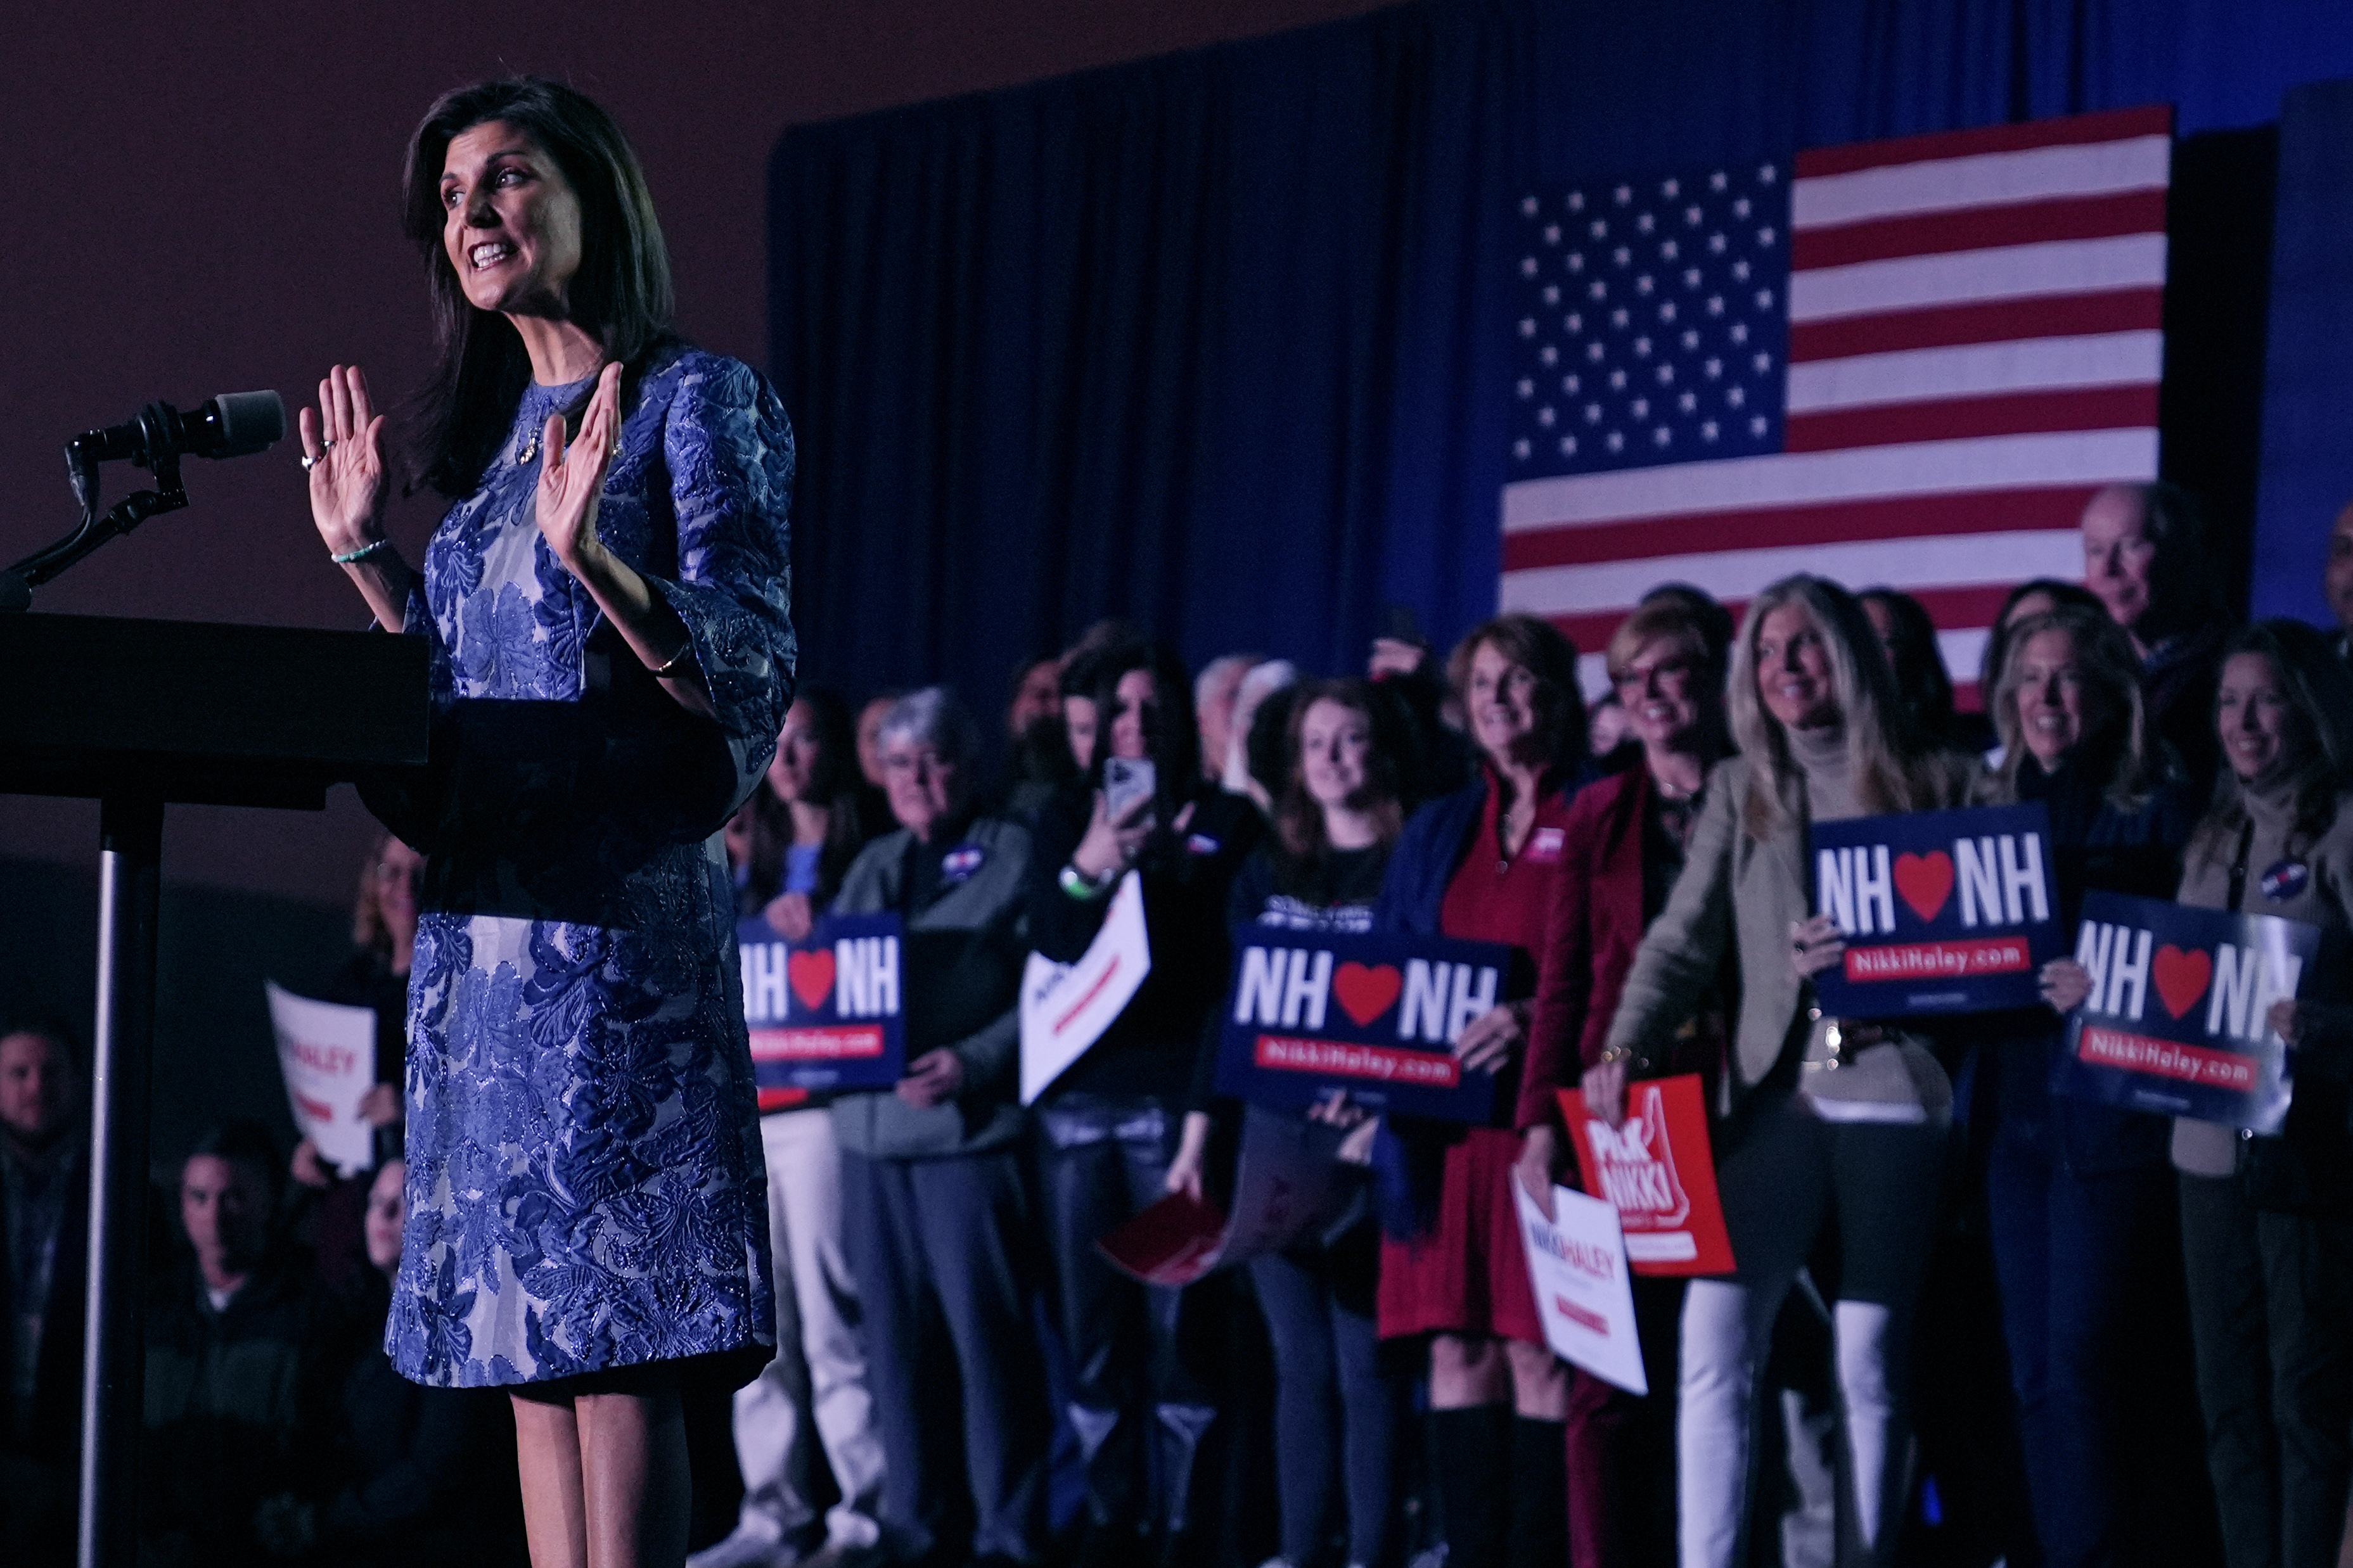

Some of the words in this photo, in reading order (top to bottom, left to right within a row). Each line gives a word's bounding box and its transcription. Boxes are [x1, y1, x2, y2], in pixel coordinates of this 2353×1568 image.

[1816, 844, 1896, 936] NH
[1953, 831, 2049, 928] NH
[836, 935, 900, 1019] NH
[1854, 945, 2020, 973] NikkiHaley.com
[2075, 919, 2153, 1022] NH
[1233, 945, 1333, 1031] NH
[1397, 958, 1498, 1047] NH
[1262, 1039, 1452, 1080] NikkiHaley.com
[2090, 1031, 2248, 1082] NikkiHaley.com
[1598, 1161, 1674, 1211] NIKKI
